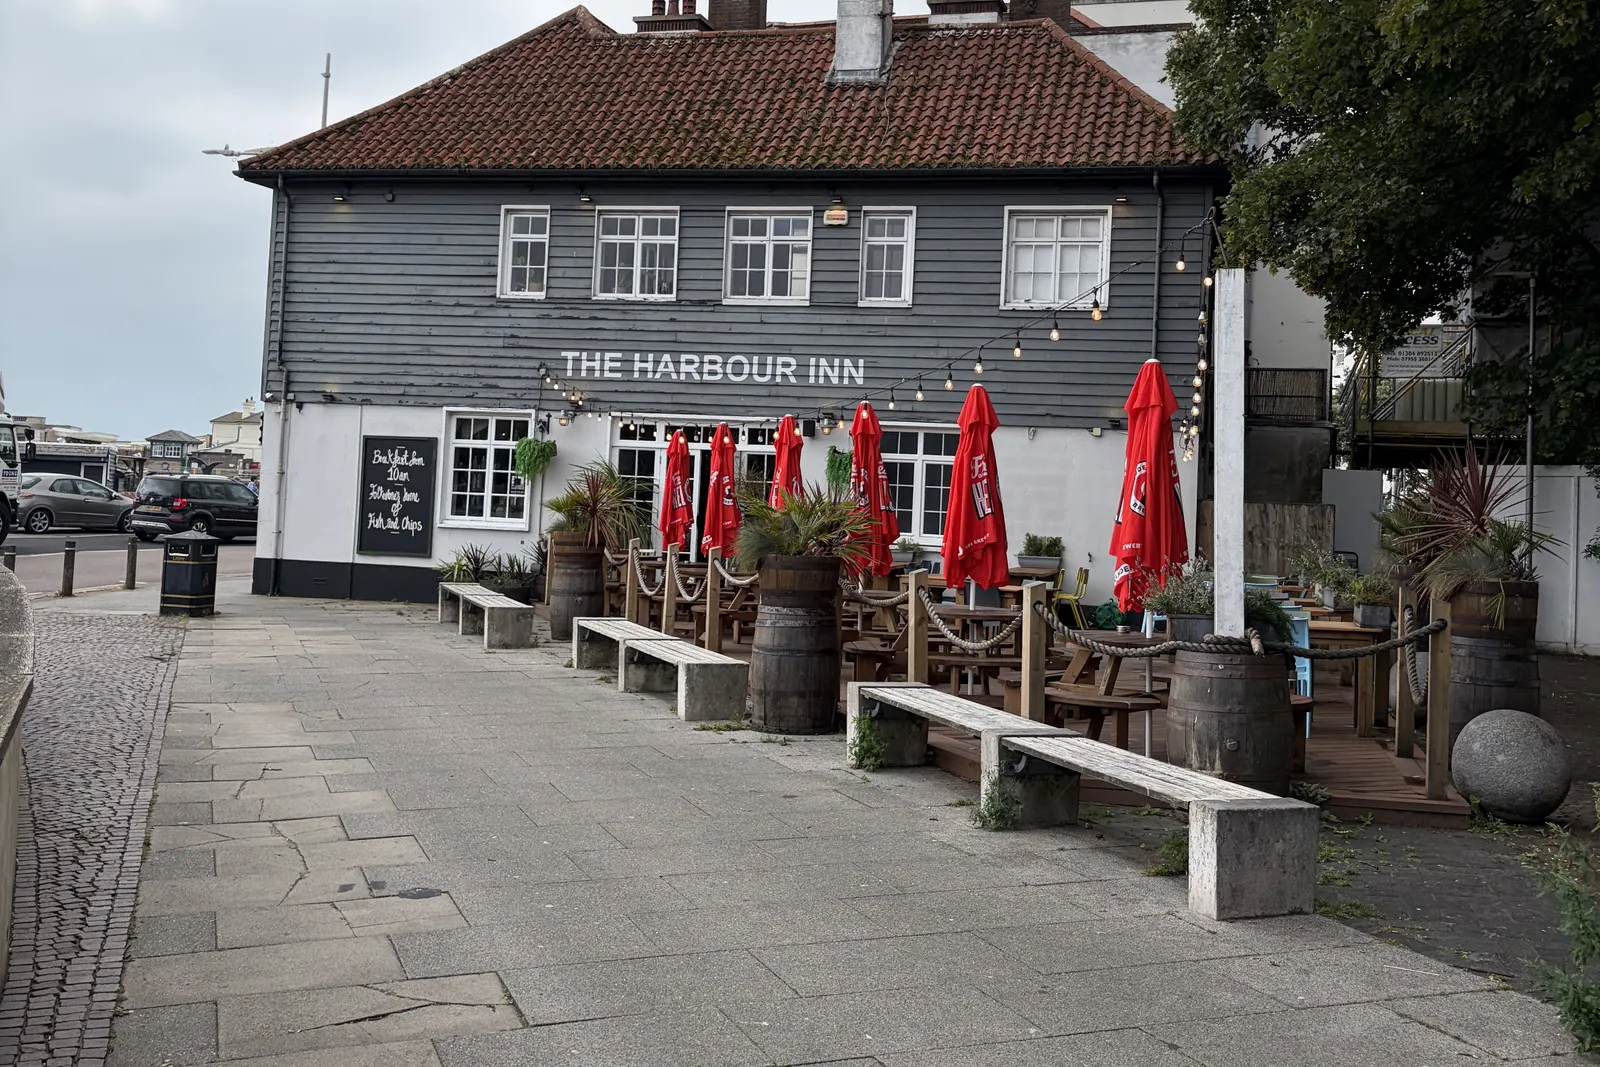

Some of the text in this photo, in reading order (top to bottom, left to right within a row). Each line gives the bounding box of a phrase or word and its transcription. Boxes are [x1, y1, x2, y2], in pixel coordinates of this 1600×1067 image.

[1404, 336, 1439, 345] CESS
[561, 351, 865, 385] THE HARBOUR INN
[373, 449, 409, 467] Breakfast
[387, 467, 410, 481] 10am
[391, 500, 402, 516] of
[367, 512, 422, 537] Fish and Chips
